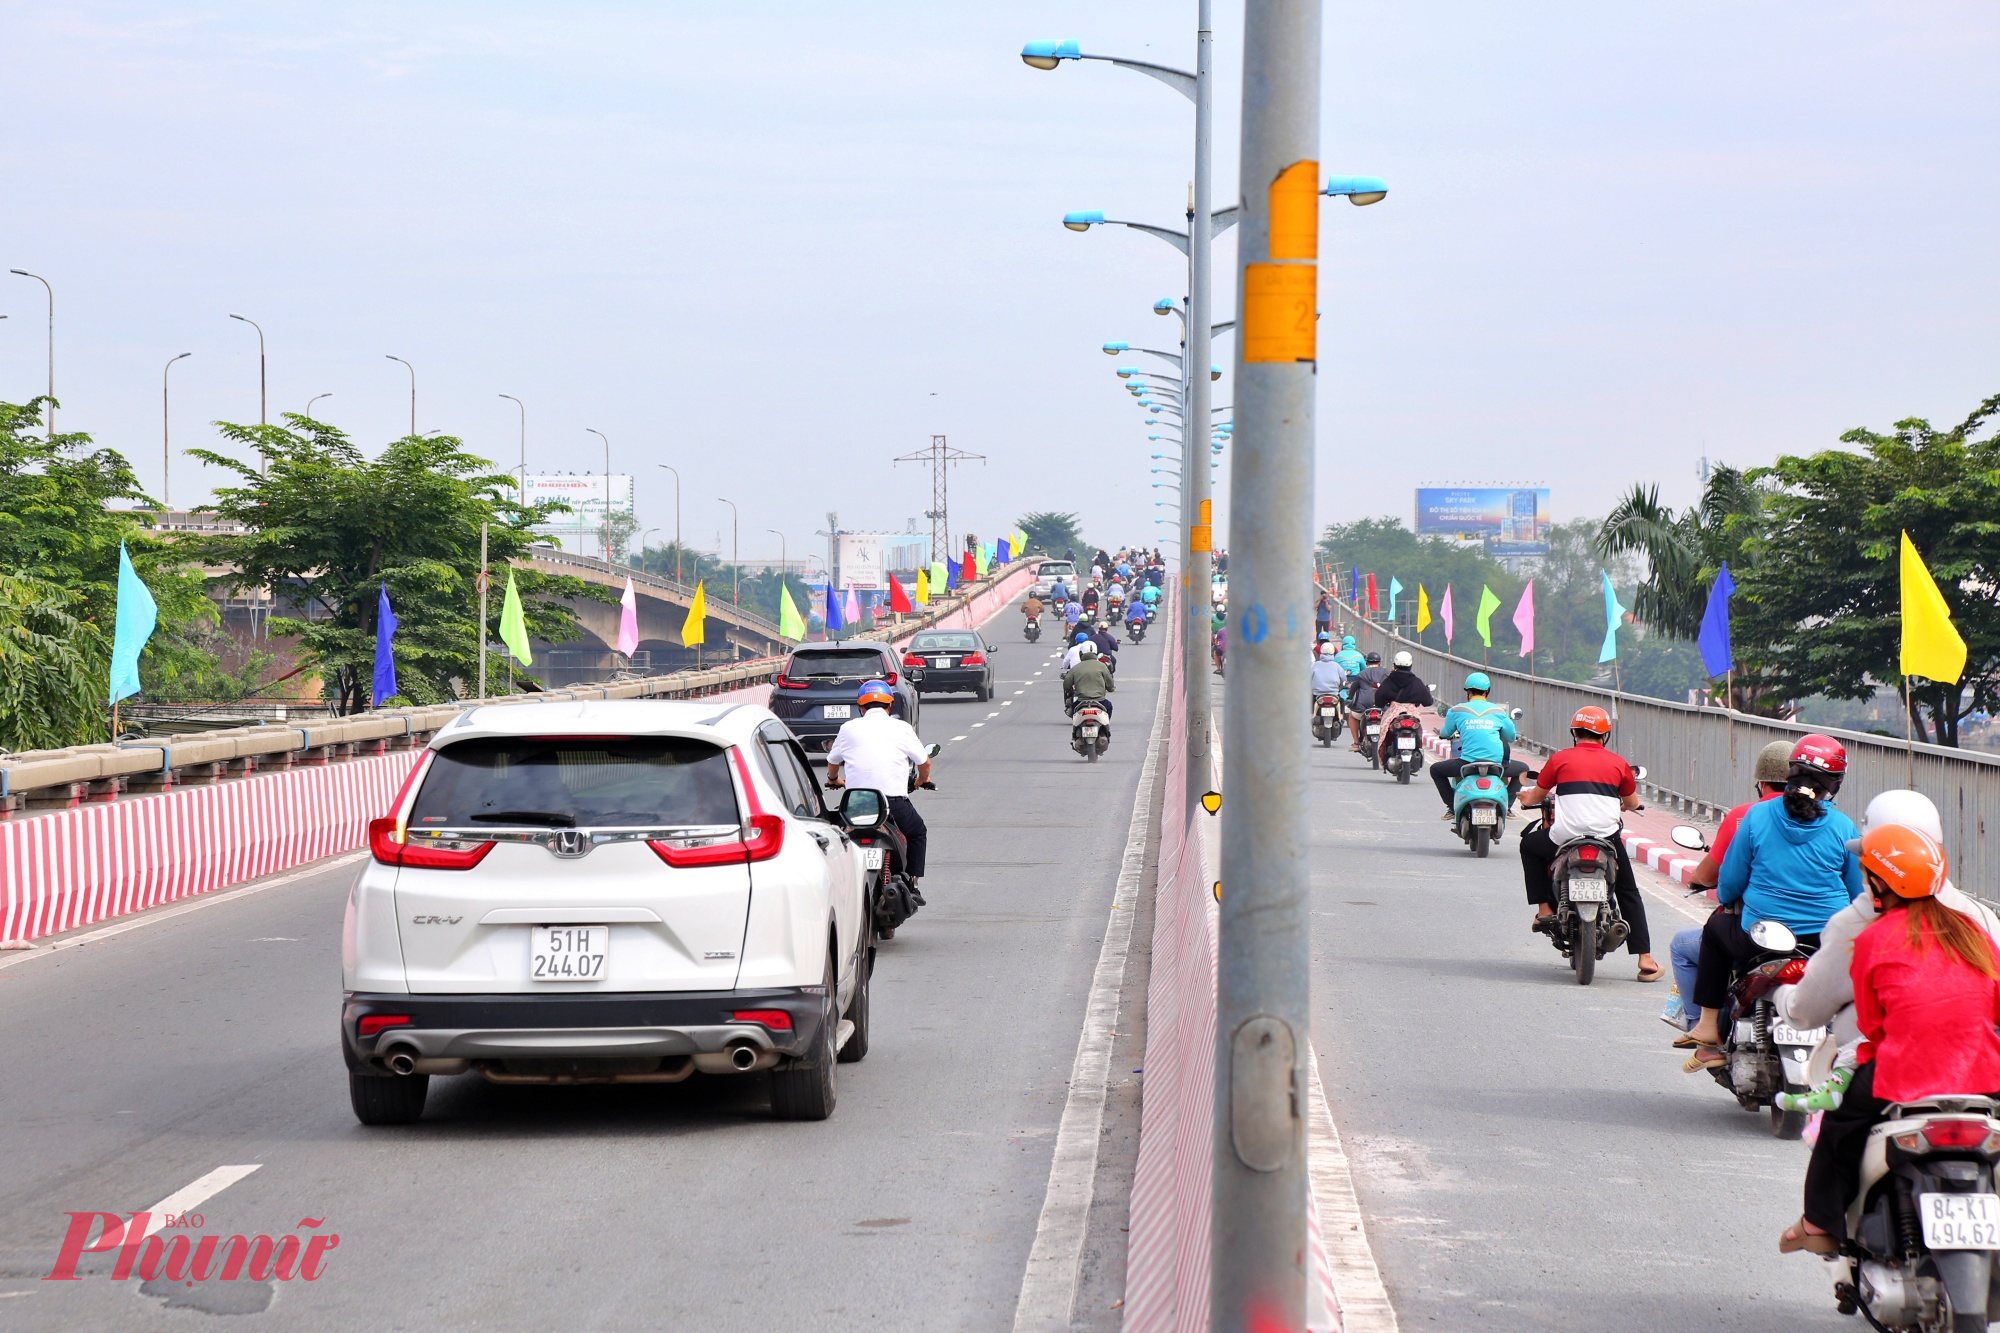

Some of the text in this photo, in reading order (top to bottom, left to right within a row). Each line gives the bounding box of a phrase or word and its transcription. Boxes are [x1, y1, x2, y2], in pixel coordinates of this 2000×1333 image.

[1294, 301, 1309, 333] 2
[1870, 849, 1906, 879] LALAMOVE
[1571, 890, 1604, 900] 254.64
[1574, 881, 1601, 890] 59-S2
[413, 915, 464, 926] CR-V
[550, 930, 590, 952] 51H
[533, 955, 605, 977] 244.07
[1934, 1198, 1987, 1220] 84-K1
[1932, 1223, 1997, 1245] 494.62
